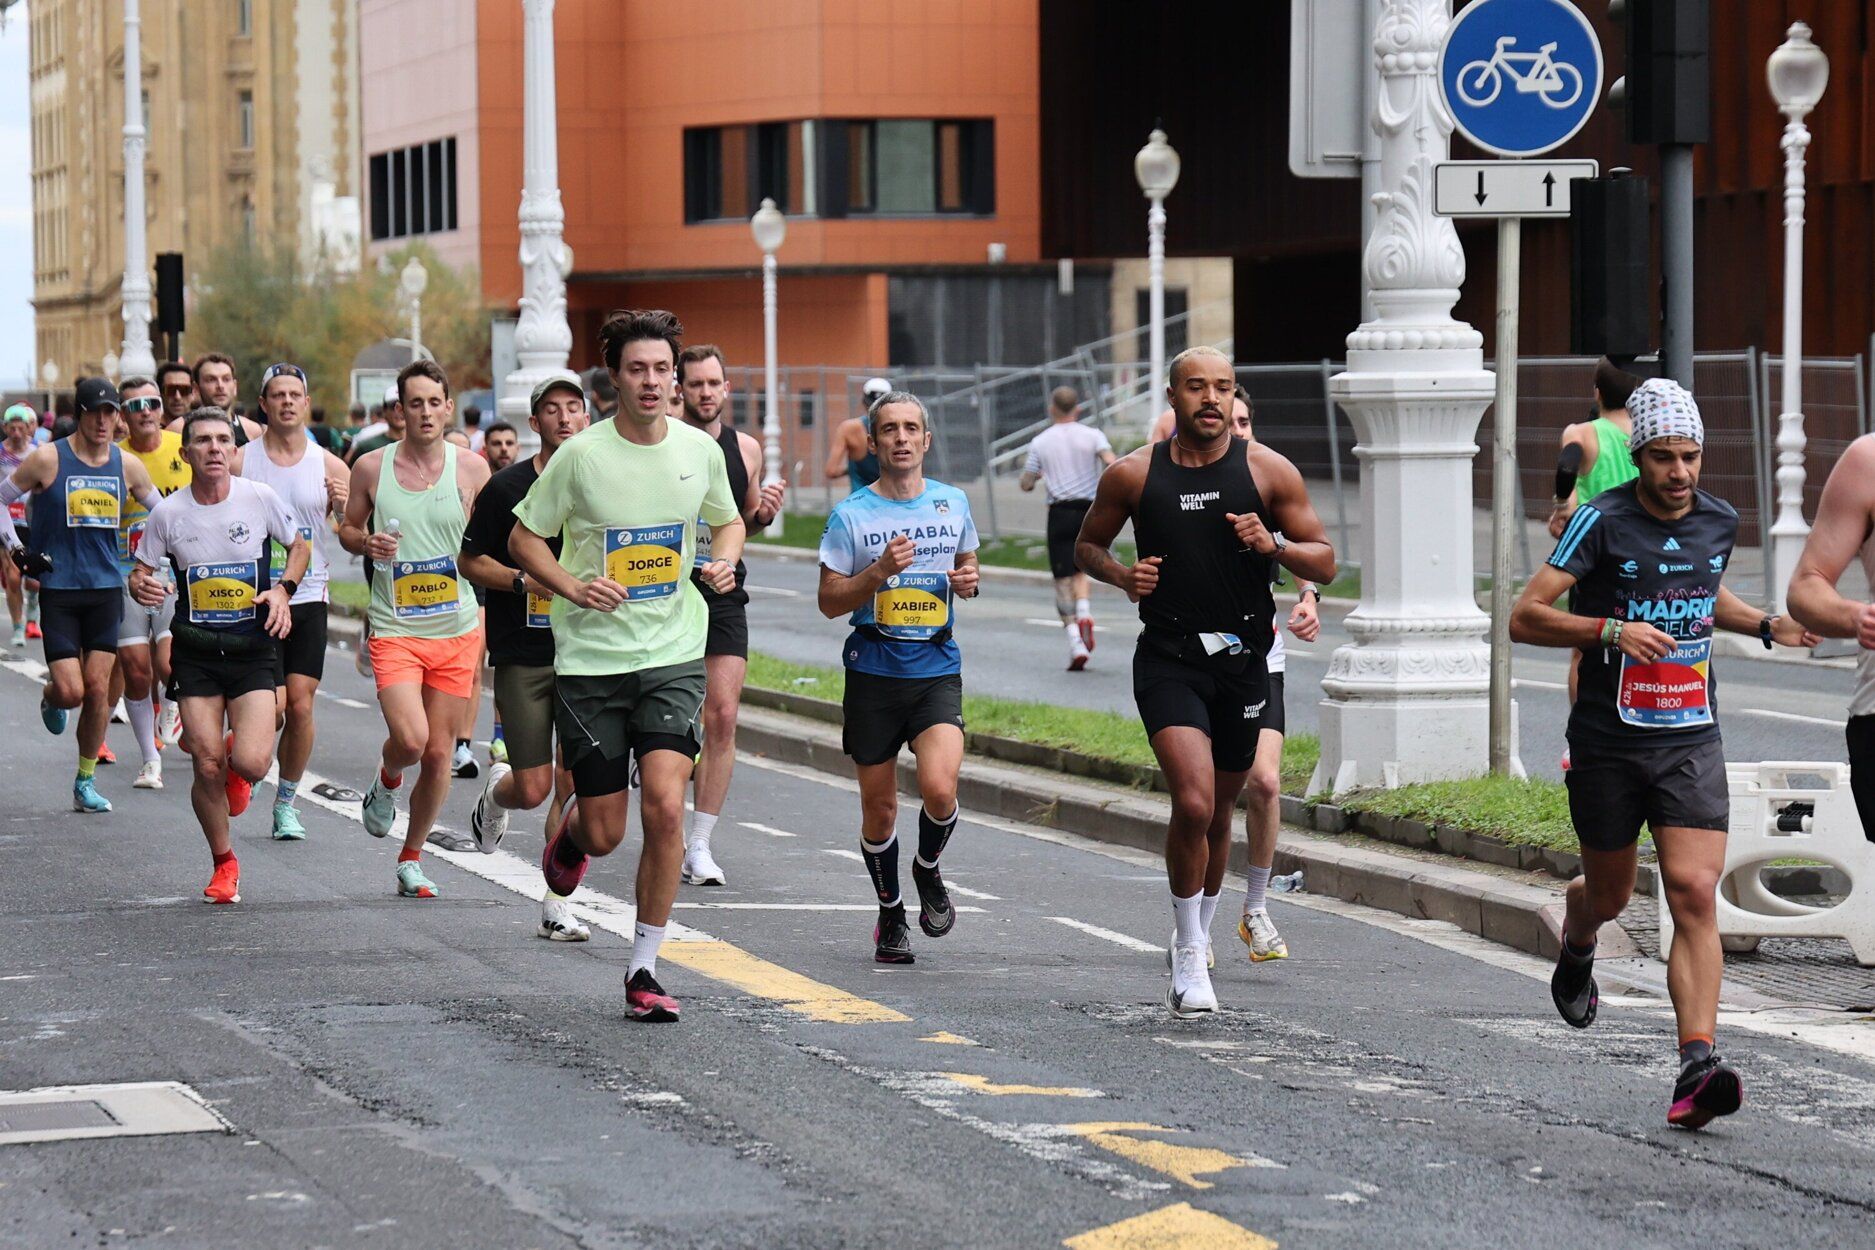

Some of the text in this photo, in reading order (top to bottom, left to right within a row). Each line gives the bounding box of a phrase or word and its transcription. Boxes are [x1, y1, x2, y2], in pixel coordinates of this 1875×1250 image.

[80, 497, 113, 506] DANIEL
[1179, 491, 1220, 502] VITAMIN
[1180, 501, 1205, 510] WELL
[637, 529, 674, 542] ZURICH
[863, 525, 958, 547] IDIAZABAL
[416, 560, 447, 571] ZURICH
[627, 556, 672, 571] JORGE
[1669, 564, 1694, 572] ZURICH
[212, 566, 245, 575] ZURICH
[640, 574, 657, 585] 736
[903, 577, 937, 586] ZURICH
[411, 581, 448, 593] PABLO
[209, 588, 244, 598] XISCO
[215, 601, 235, 609] 1302
[421, 595, 436, 605] 732
[892, 601, 938, 611] XABIER
[903, 616, 921, 625] 997
[1664, 647, 1701, 659] URICH
[1632, 682, 1667, 693] JESÚS
[1668, 681, 1704, 693] MANUEL
[1655, 697, 1682, 708] 1800
